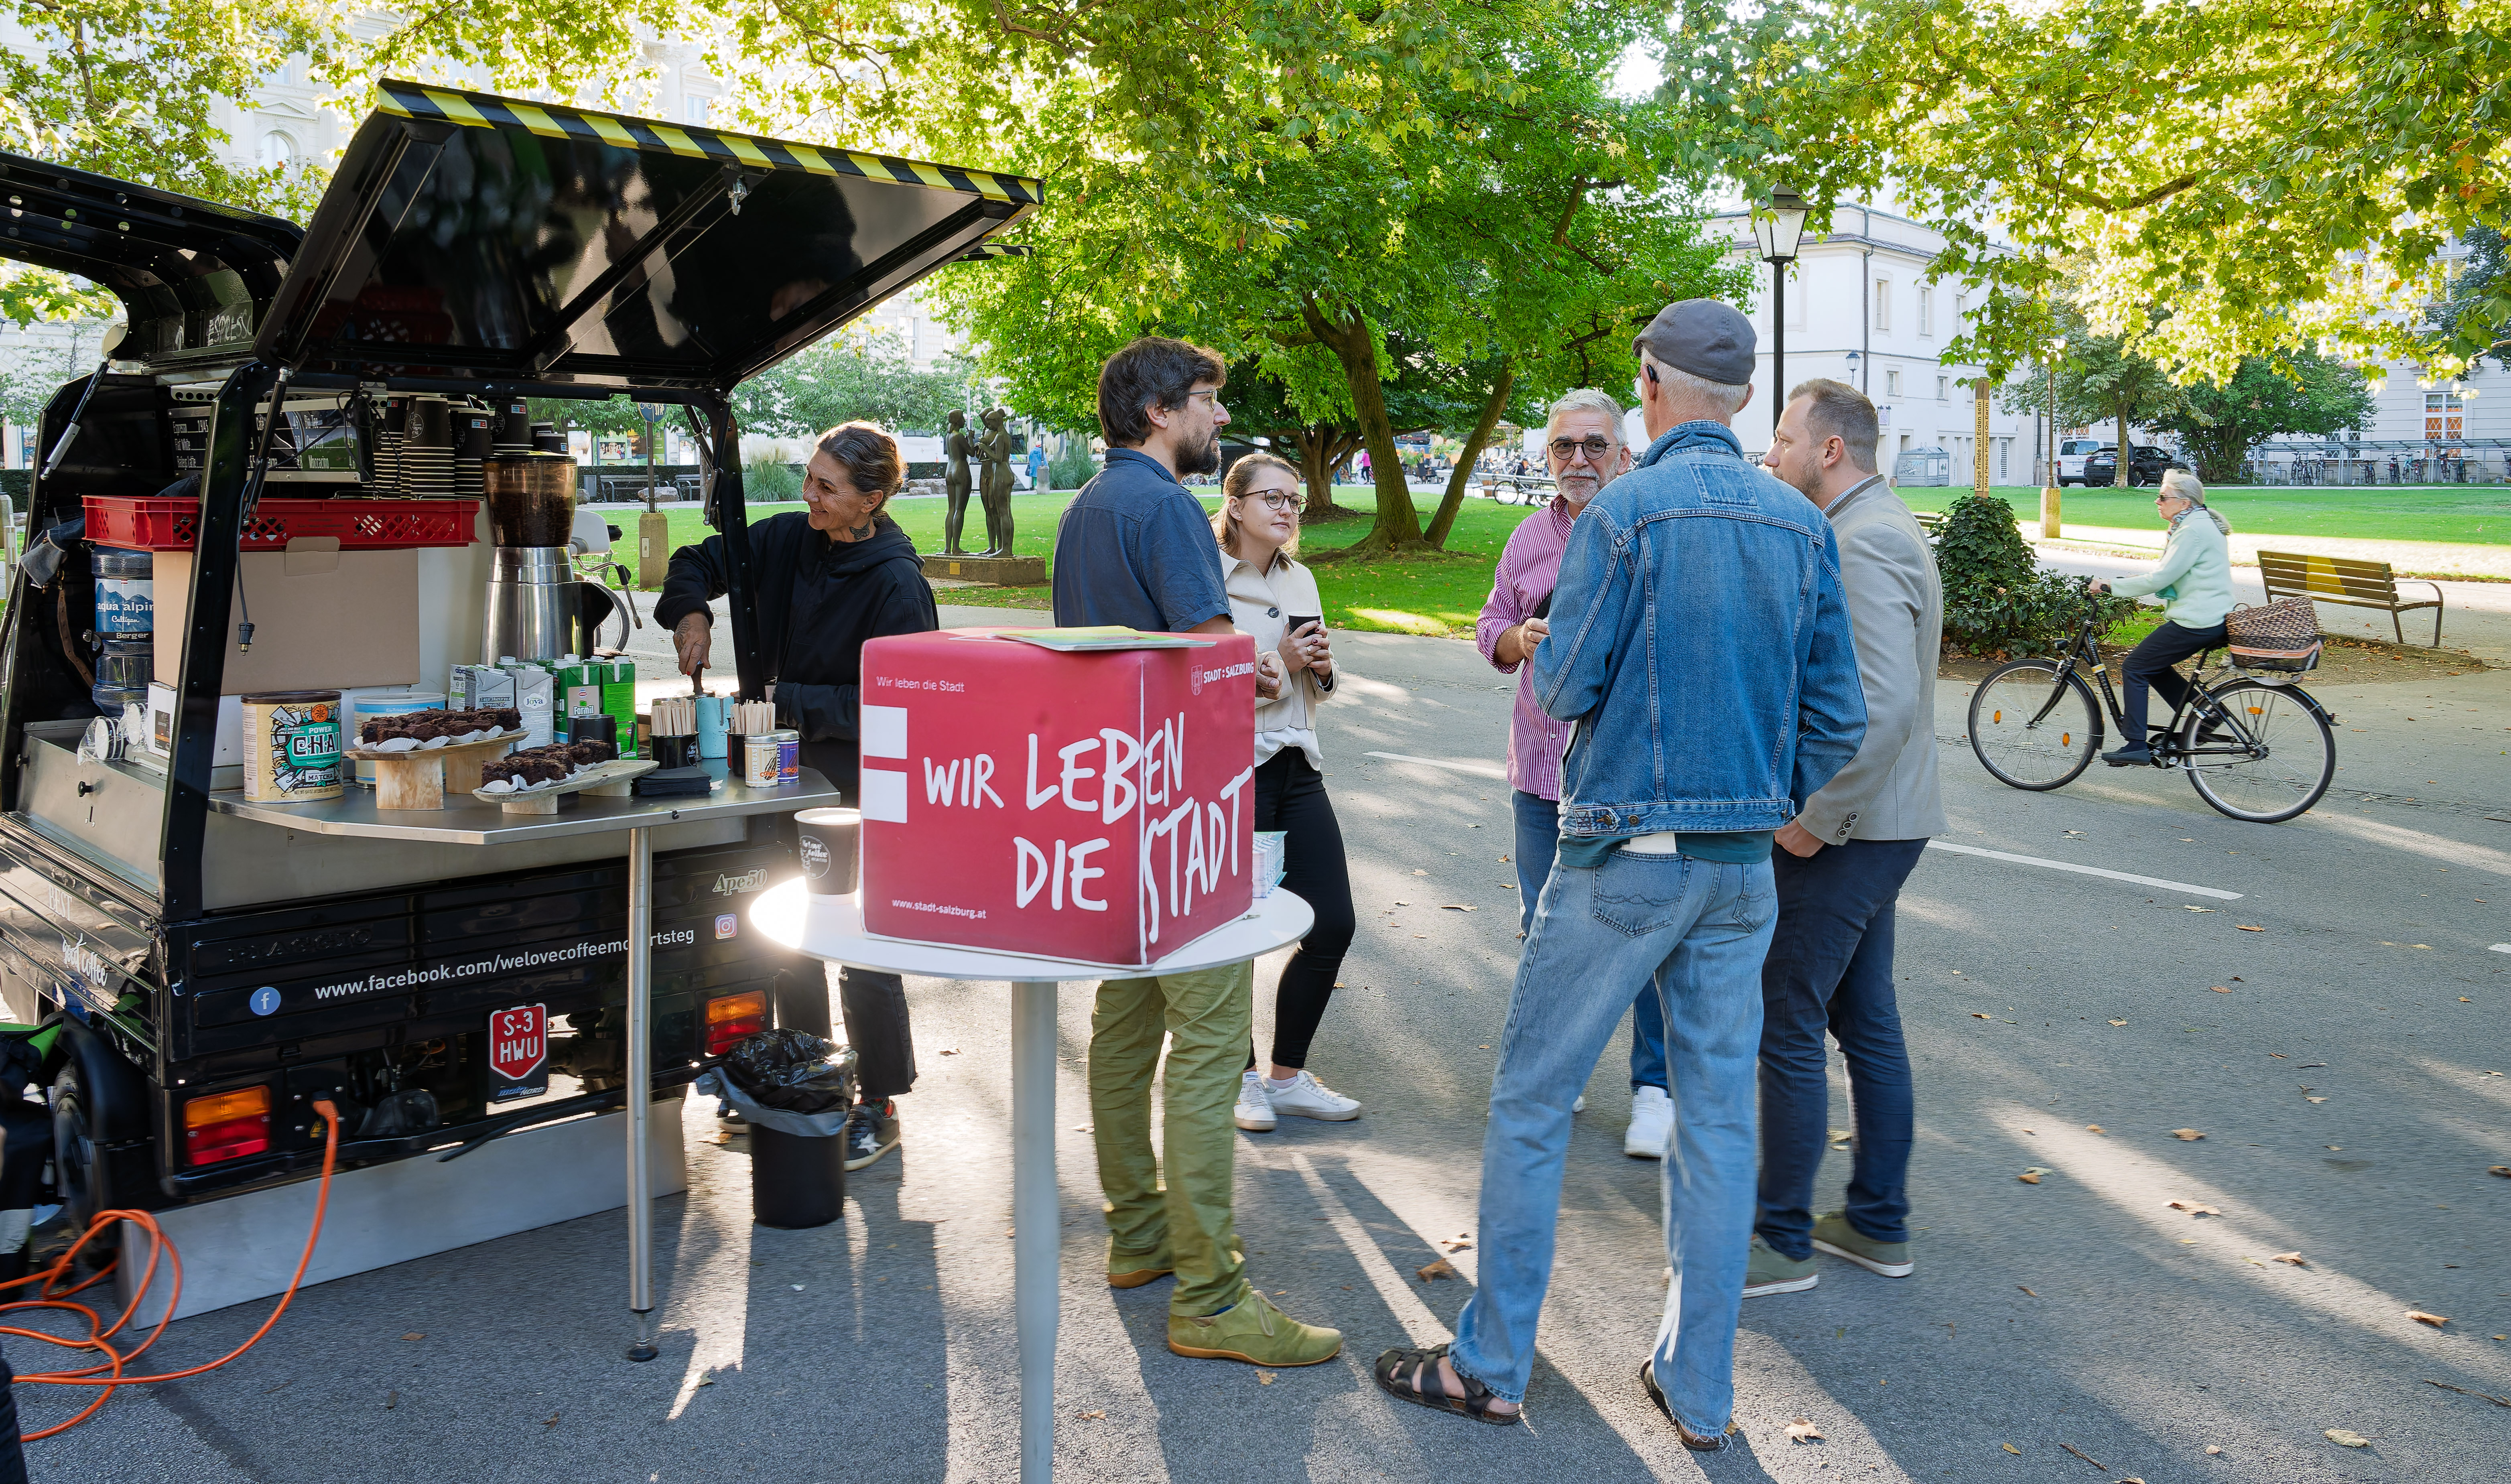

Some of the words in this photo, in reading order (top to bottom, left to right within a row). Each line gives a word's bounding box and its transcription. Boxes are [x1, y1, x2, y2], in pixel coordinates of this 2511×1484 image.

[1985, 421, 1988, 430] On
[97, 603, 120, 613] aqua
[112, 615, 140, 625] Culligan
[1225, 662, 1254, 678] SALZBURG
[876, 676, 893, 687] Wir
[895, 678, 920, 689] leben
[922, 680, 937, 690] die
[939, 680, 965, 692] Stadt
[526, 698, 543, 706] Joya
[573, 705, 594, 715] Formil
[309, 726, 332, 734] POWER
[292, 732, 340, 757] CHAI
[923, 753, 1005, 809] WIR
[1026, 712, 1185, 825] LEBEN
[308, 773, 333, 781] MATCHA
[1013, 836, 1110, 912] DIE
[1144, 765, 1253, 944] STADT
[49, 884, 72, 922] BEST
[892, 899, 987, 920] www.stadt-salzburg.at
[504, 1011, 533, 1036] S-3
[500, 1036, 538, 1063] HWU
